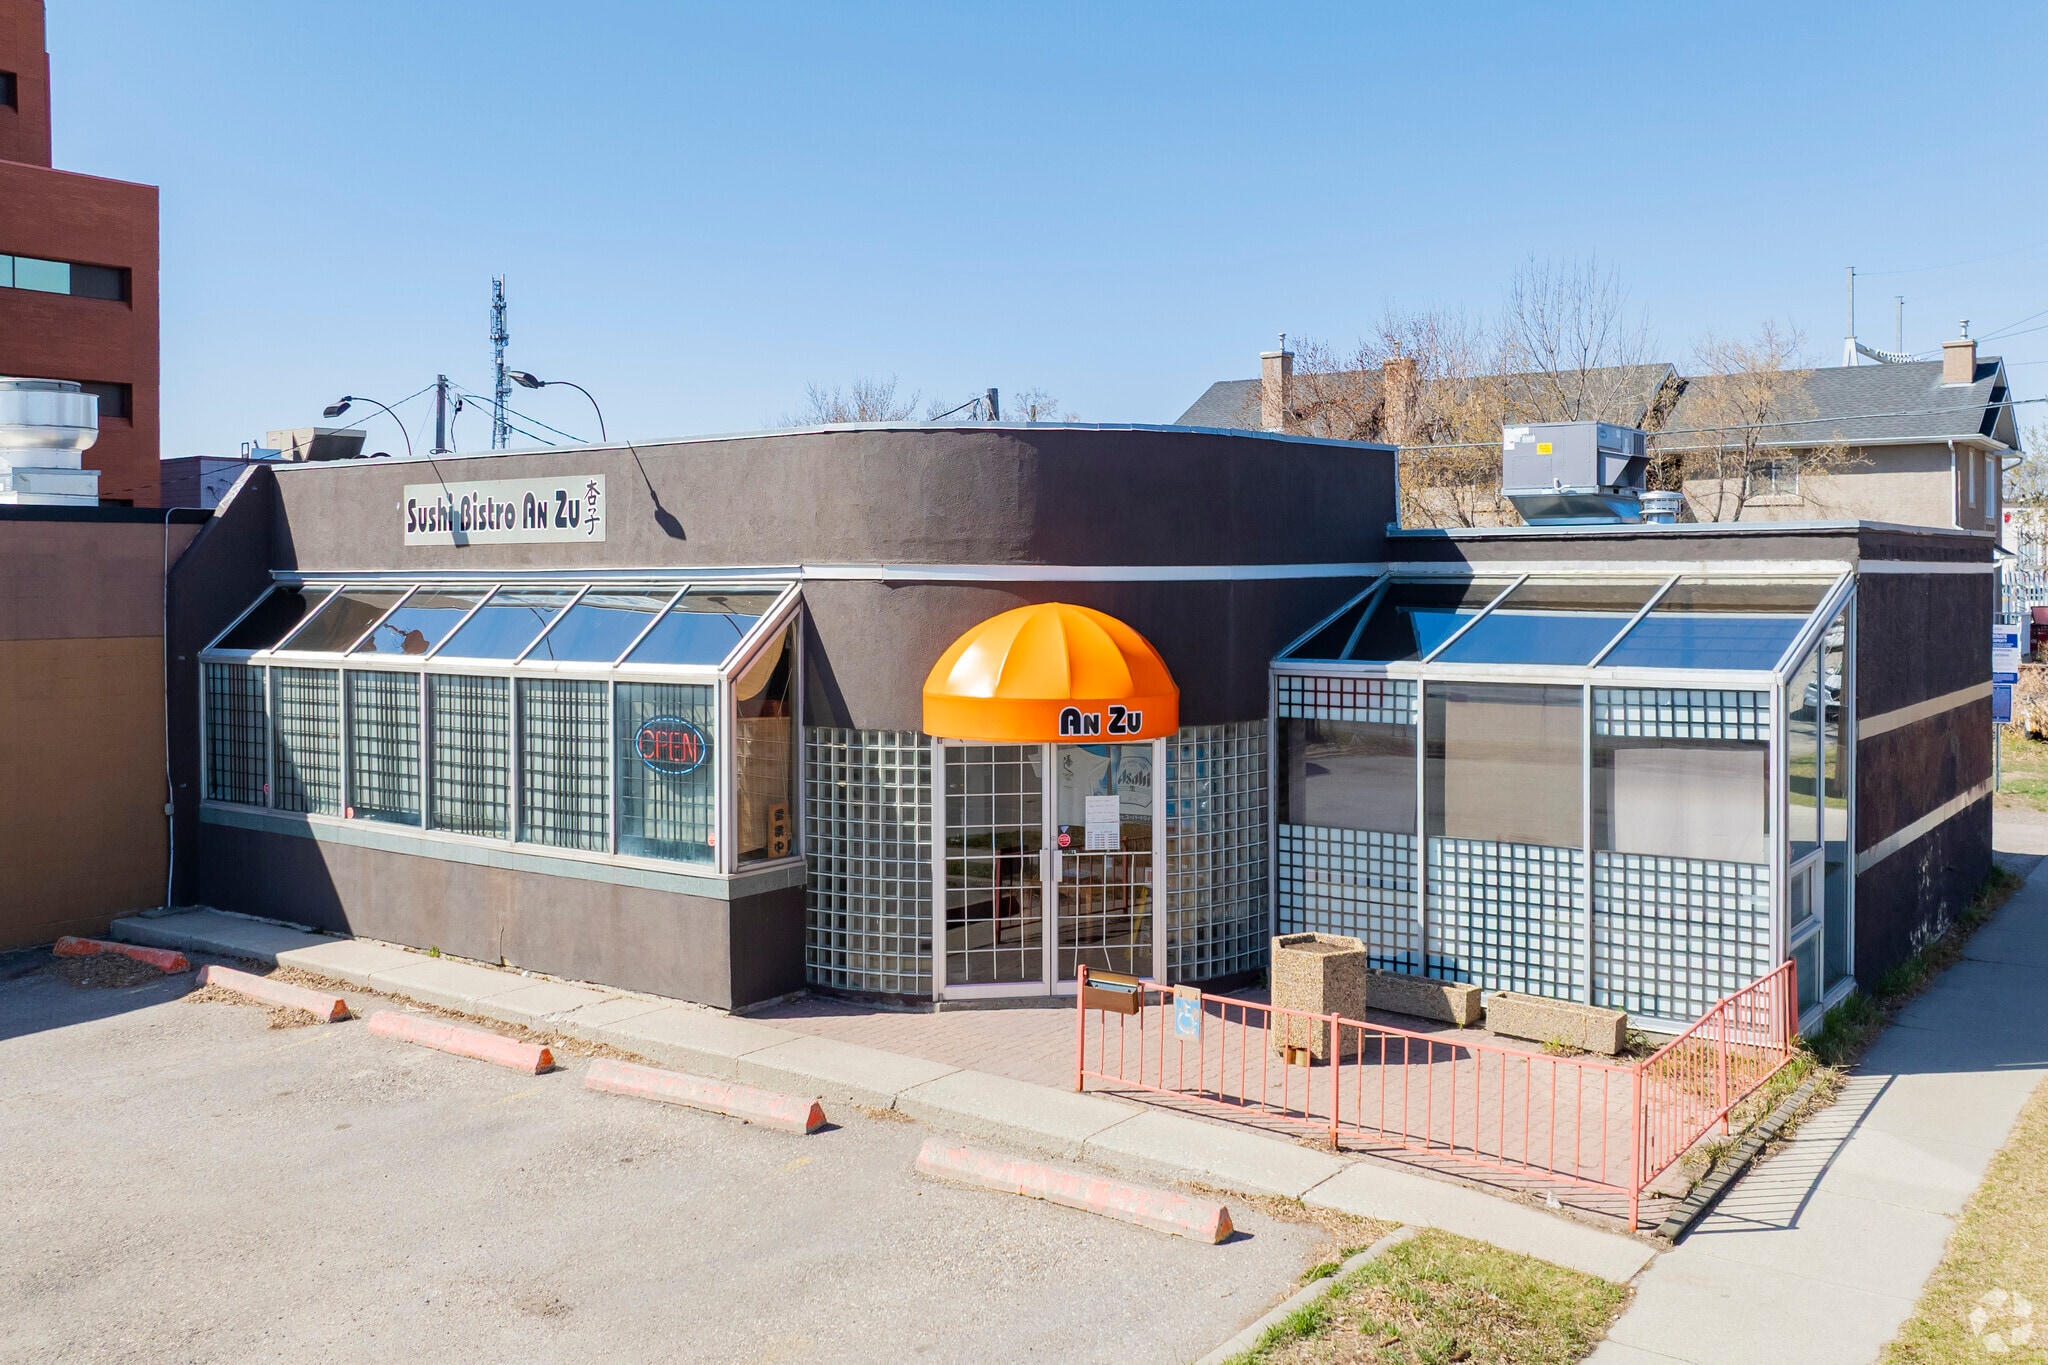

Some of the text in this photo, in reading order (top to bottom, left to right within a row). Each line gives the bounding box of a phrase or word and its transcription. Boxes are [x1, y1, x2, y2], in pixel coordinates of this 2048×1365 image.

[407, 493, 454, 533] Sushi
[460, 490, 516, 532] Bistro
[584, 479, 601, 535] 杏子
[639, 729, 697, 763] OPEN
[1118, 769, 1151, 787] Asahi
